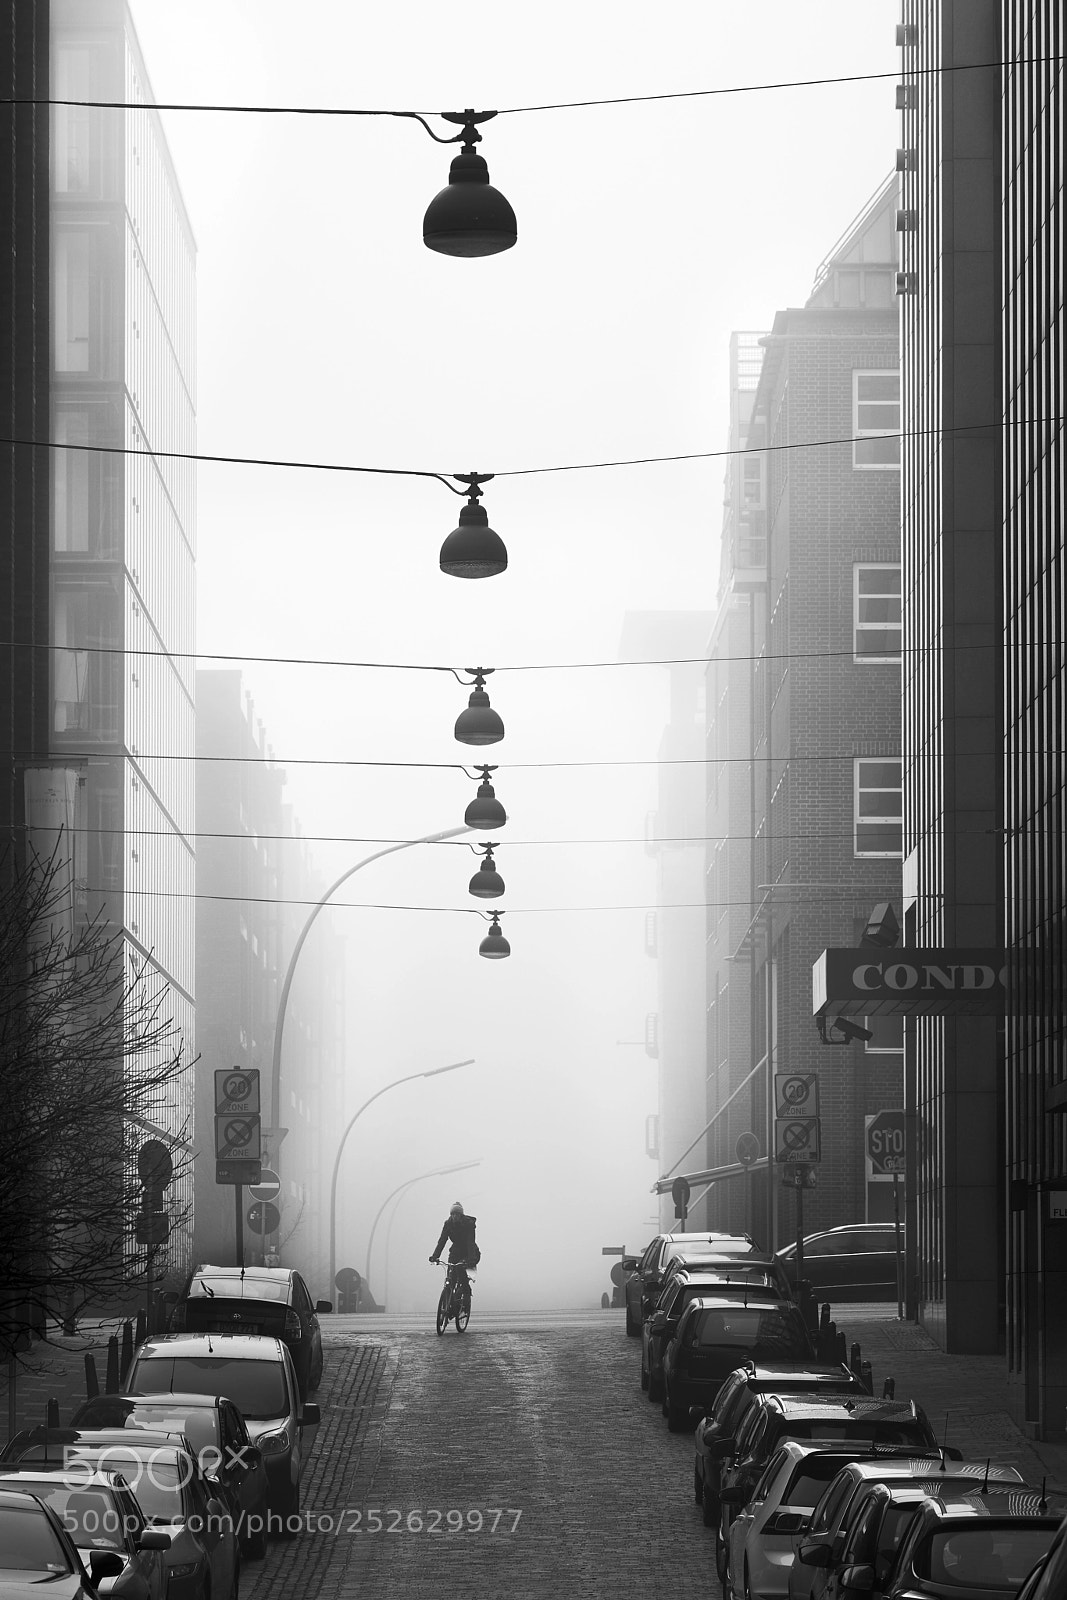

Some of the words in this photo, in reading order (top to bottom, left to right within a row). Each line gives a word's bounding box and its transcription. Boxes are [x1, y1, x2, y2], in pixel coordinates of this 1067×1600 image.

[229, 1080, 247, 1095] 20
[788, 1084, 804, 1098] 20
[227, 1103, 249, 1112] ZONE
[786, 1107, 808, 1115] ZONE
[227, 1148, 249, 1157] ZONE
